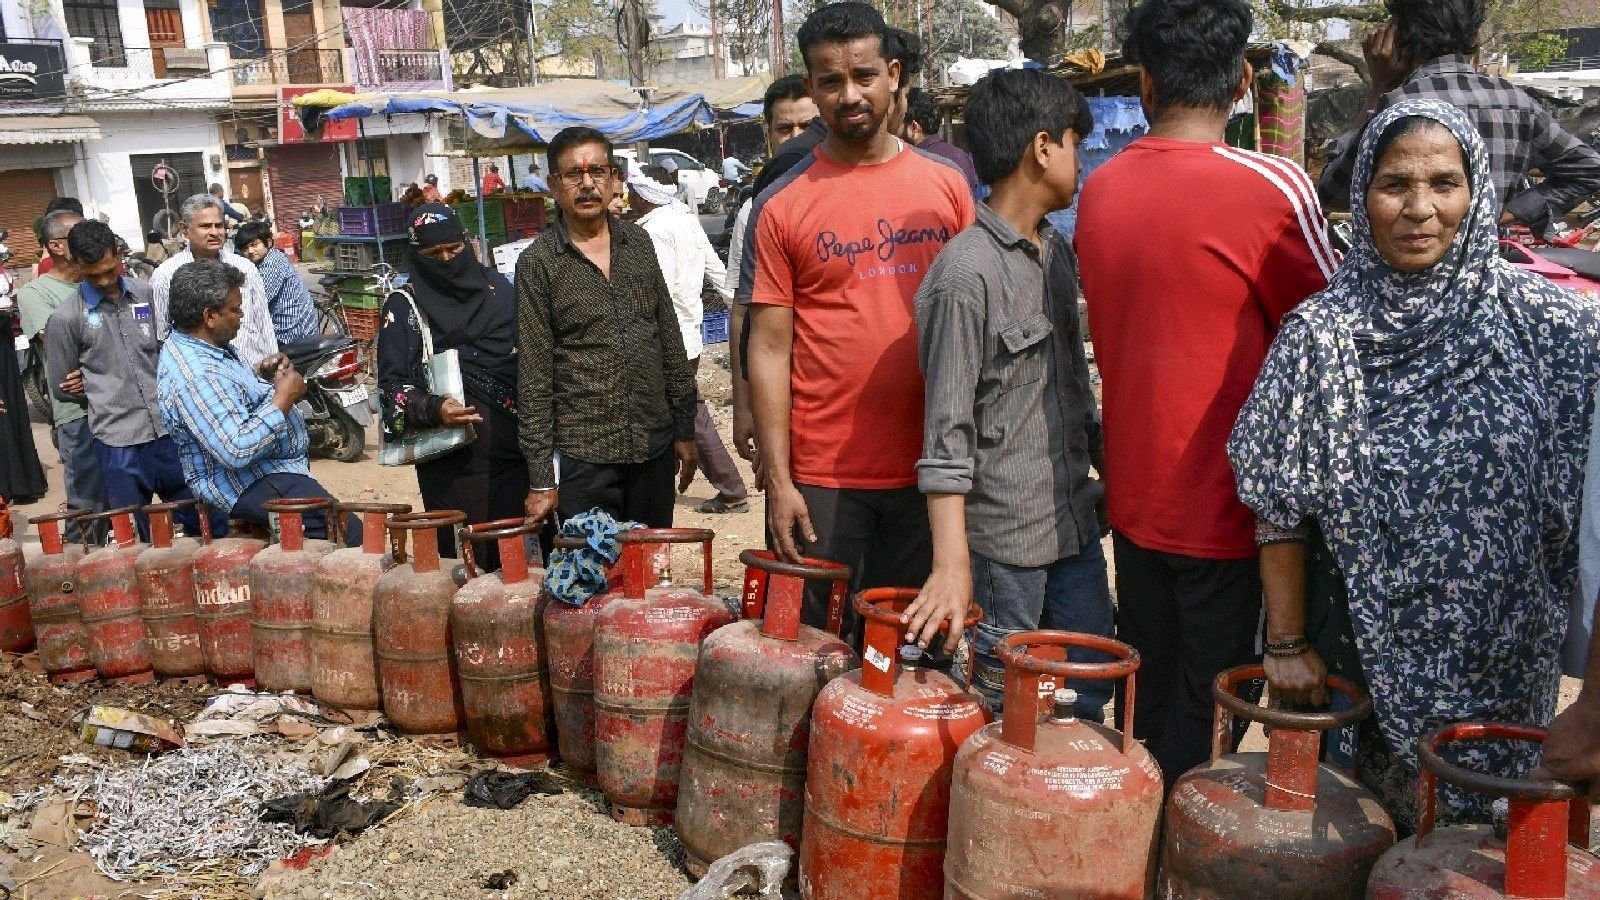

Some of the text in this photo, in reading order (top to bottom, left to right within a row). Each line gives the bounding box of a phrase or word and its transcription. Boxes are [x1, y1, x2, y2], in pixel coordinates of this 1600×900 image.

[817, 218, 952, 267] Pepe Jeans
[859, 263, 918, 280] LONDON
[746, 579, 759, 607] 15.4
[1038, 673, 1056, 699] 15.
